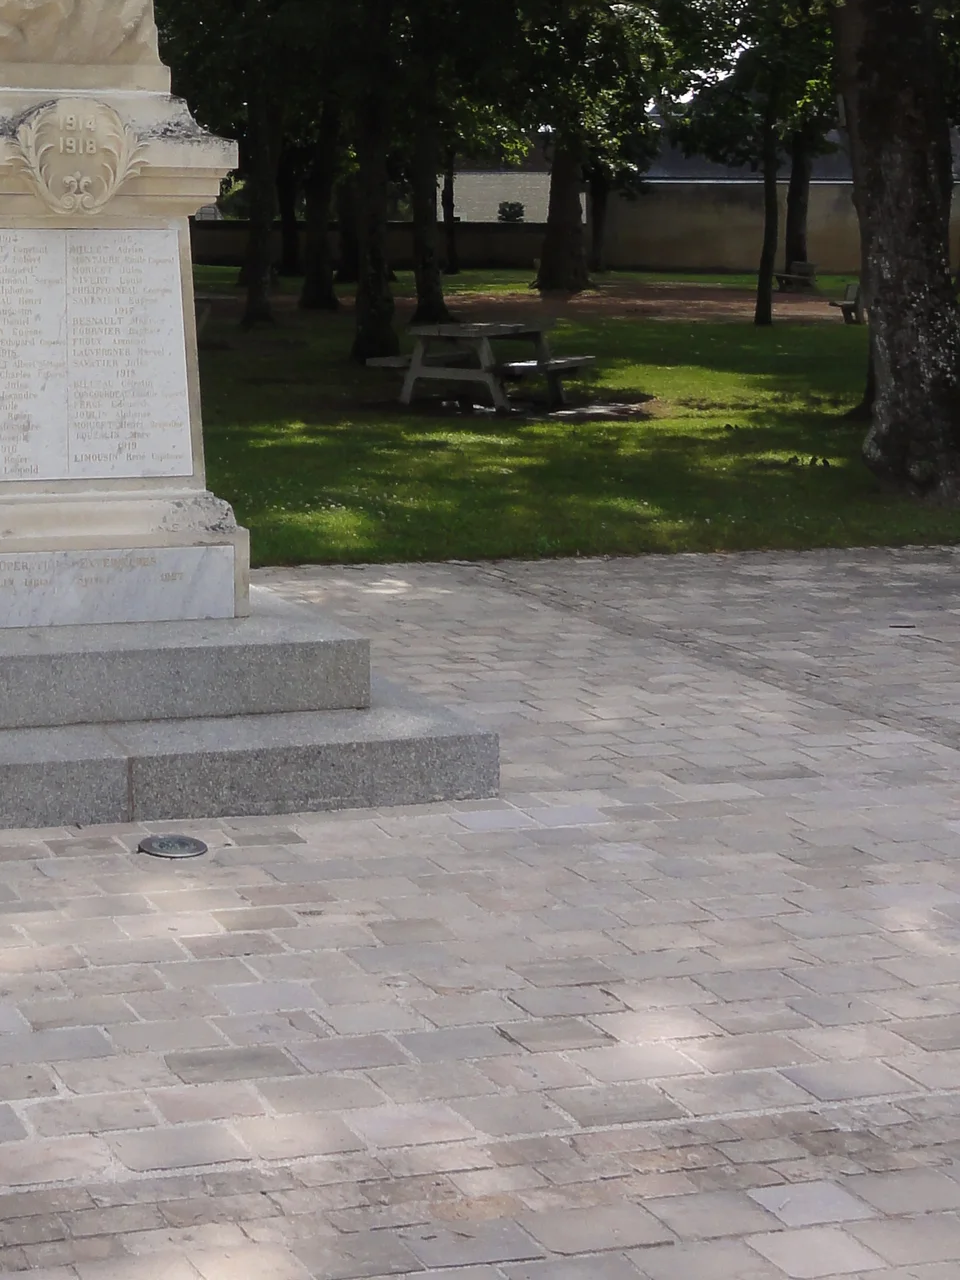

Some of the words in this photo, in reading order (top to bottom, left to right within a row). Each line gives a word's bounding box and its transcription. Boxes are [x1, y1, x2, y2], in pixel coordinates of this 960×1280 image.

[59, 114, 97, 131] 1914
[59, 136, 97, 154] 1918
[73, 452, 117, 462] LIMOUSIN
